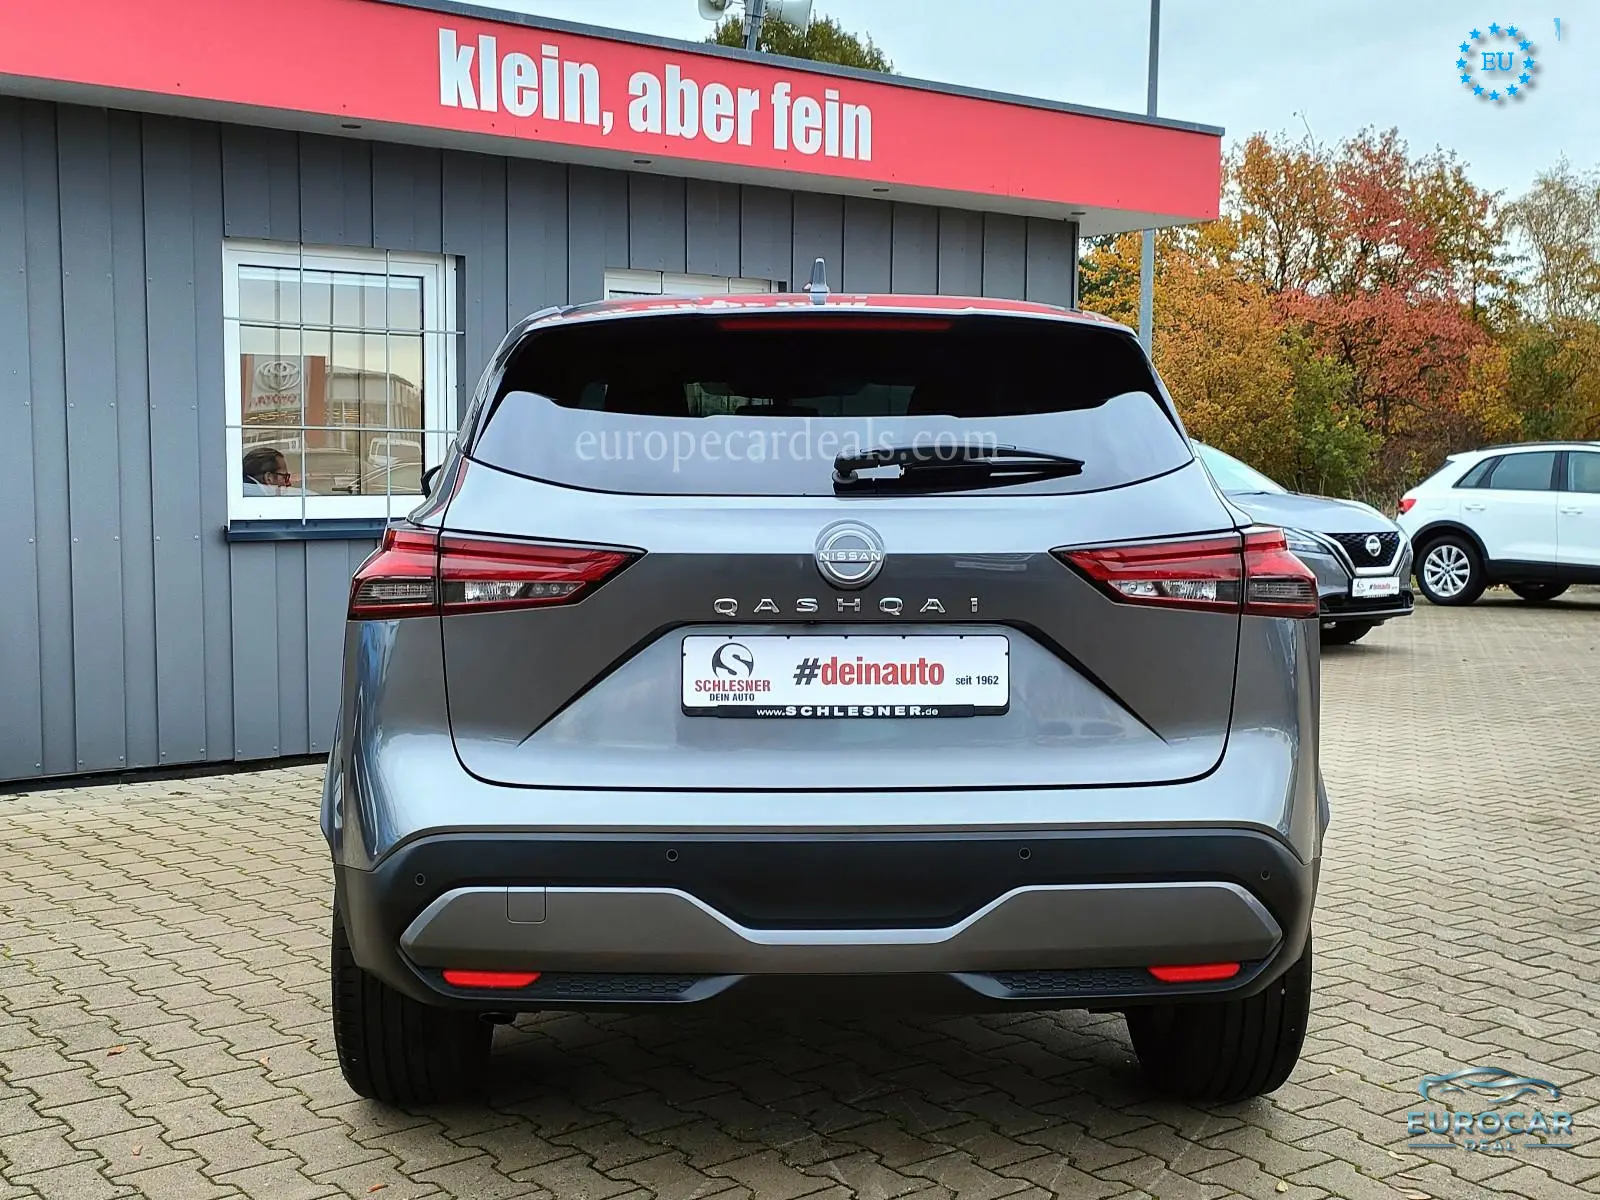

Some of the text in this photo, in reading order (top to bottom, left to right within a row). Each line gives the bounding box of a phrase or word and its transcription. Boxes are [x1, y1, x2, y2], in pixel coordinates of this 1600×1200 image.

[438, 28, 872, 161] klein, aber fein
[819, 552, 881, 561] NISSAN
[714, 598, 978, 617] QASHQAI
[793, 656, 999, 686] #deinauto seit 1962
[694, 679, 771, 692] SCHLESNER
[709, 693, 755, 702] DEIN AUTO
[756, 705, 939, 717] www.SCHLESNER.de
